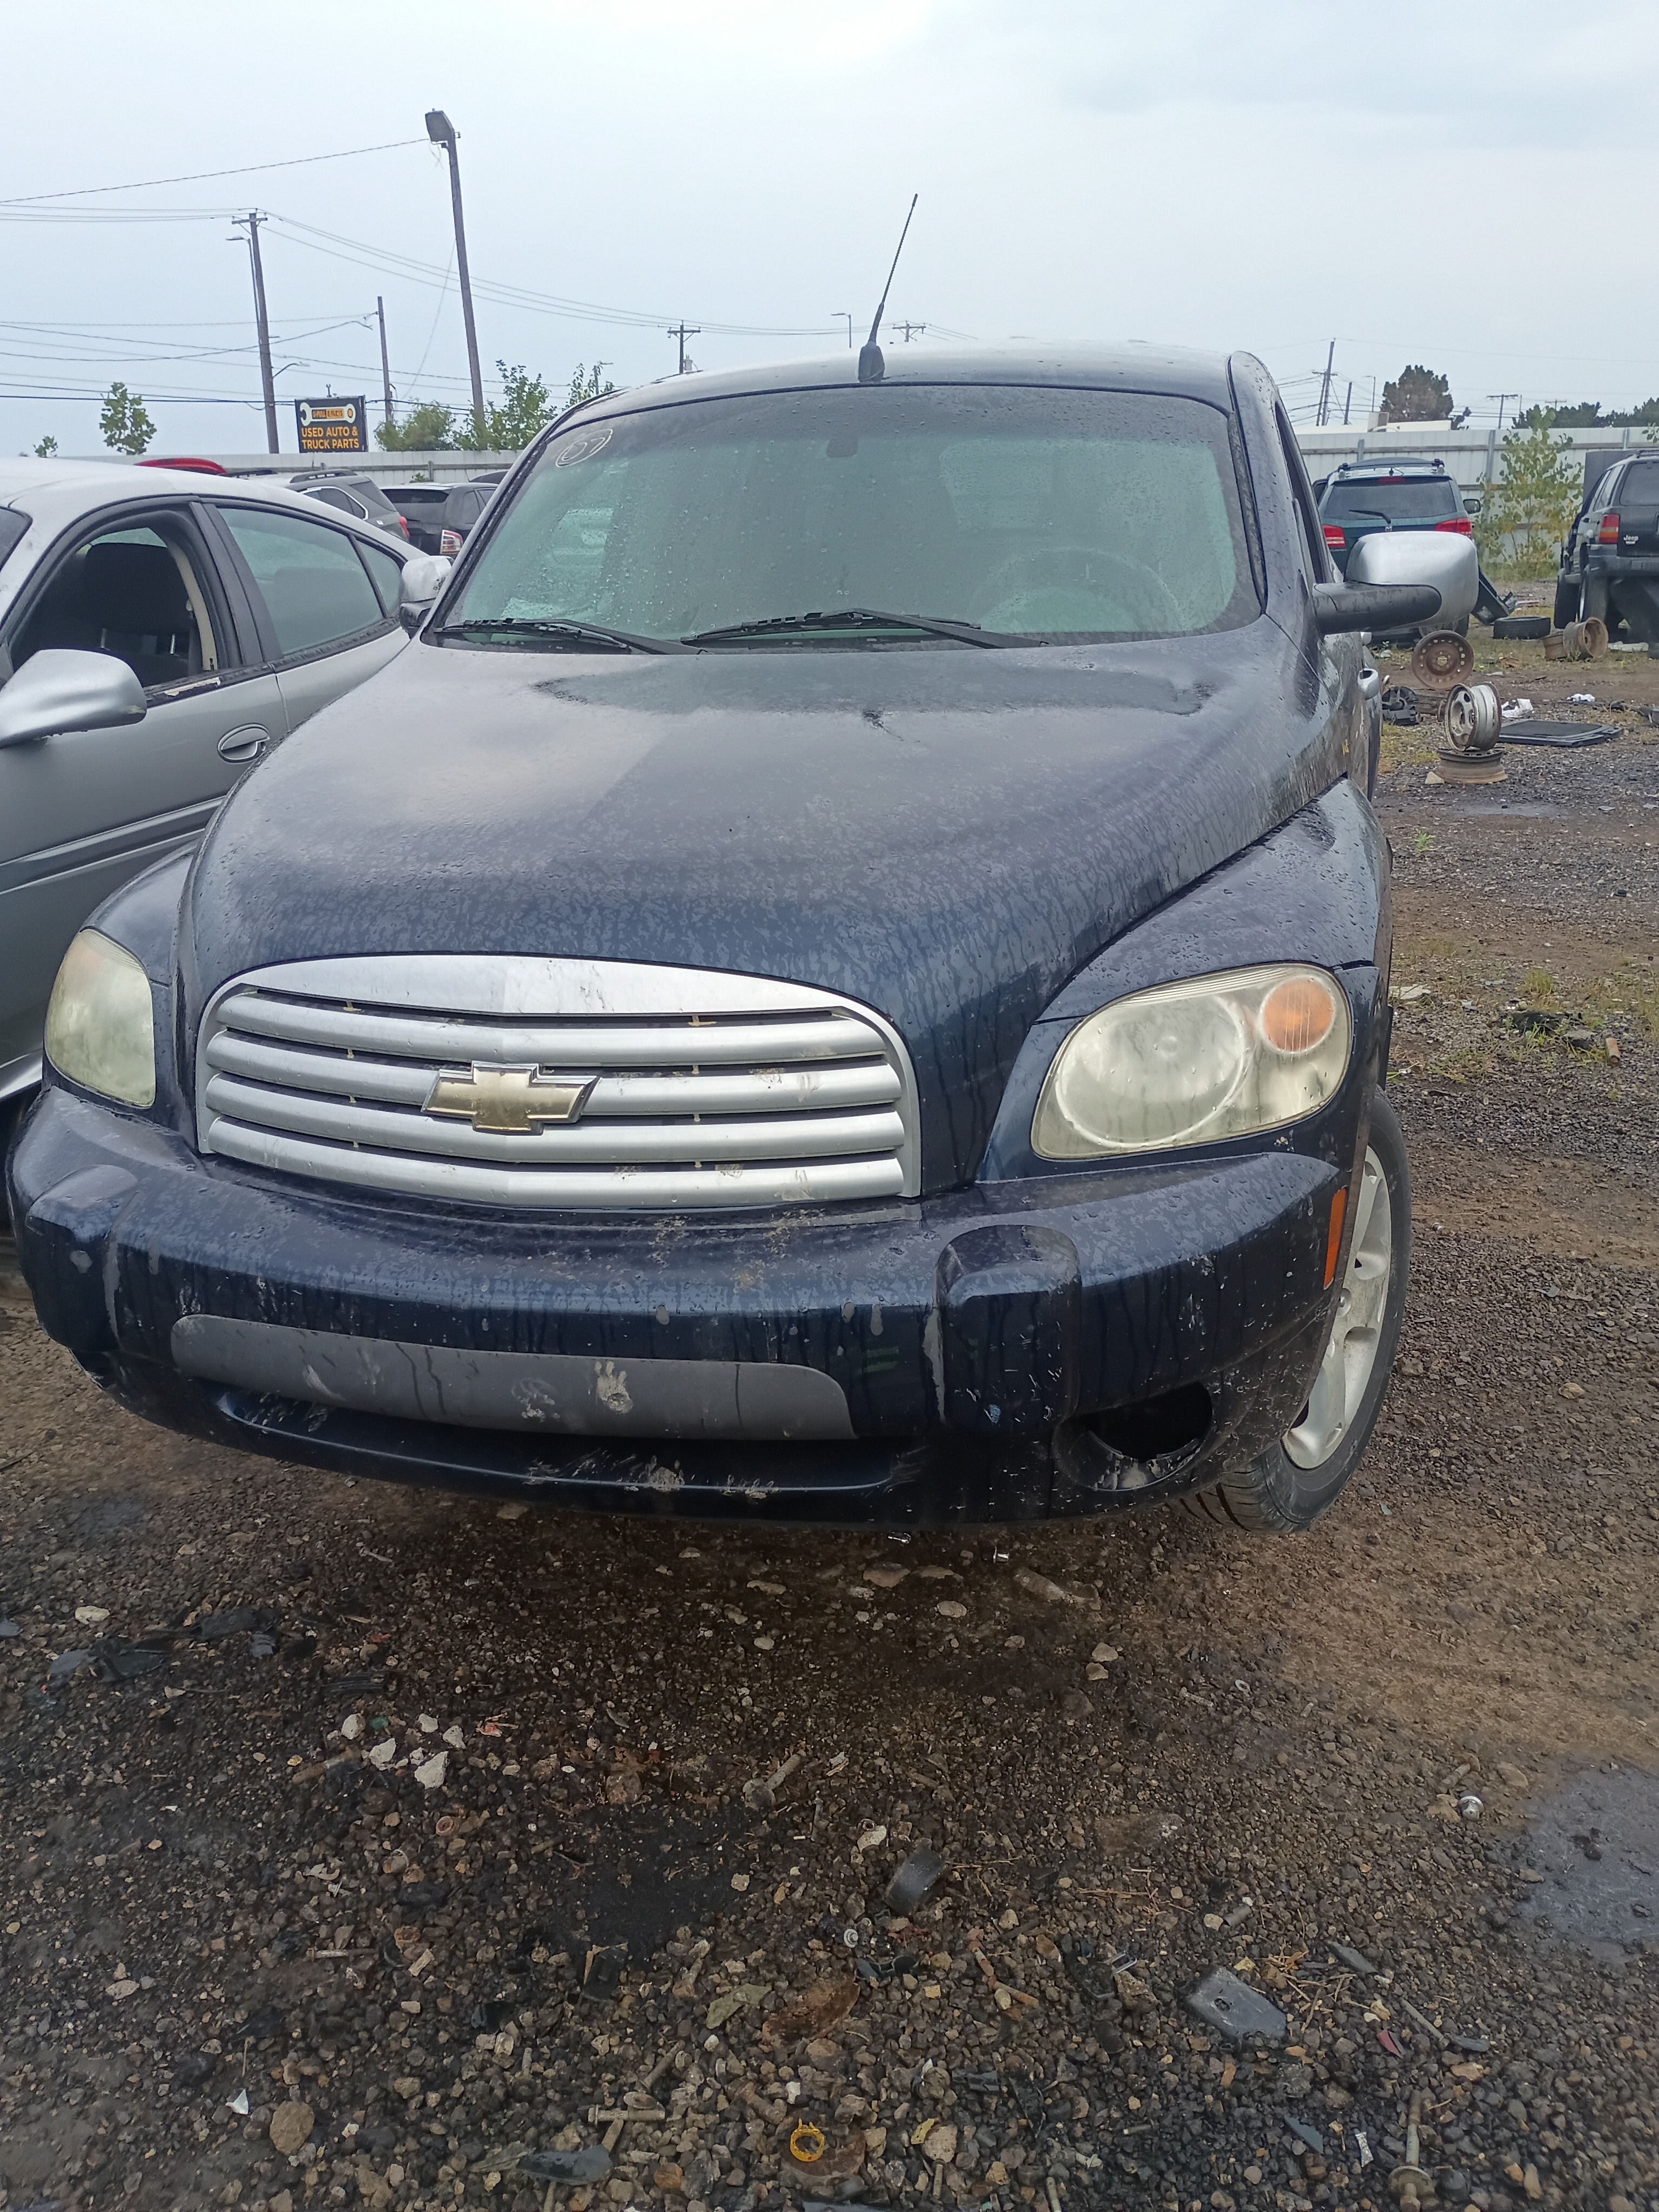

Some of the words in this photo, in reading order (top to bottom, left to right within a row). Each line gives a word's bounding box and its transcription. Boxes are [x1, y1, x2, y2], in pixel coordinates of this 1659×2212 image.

[301, 427, 323, 437] USED
[326, 426, 350, 437] AUTO
[352, 426, 358, 436] &
[302, 439, 330, 449] TRUCK
[332, 438, 359, 449] PARTS
